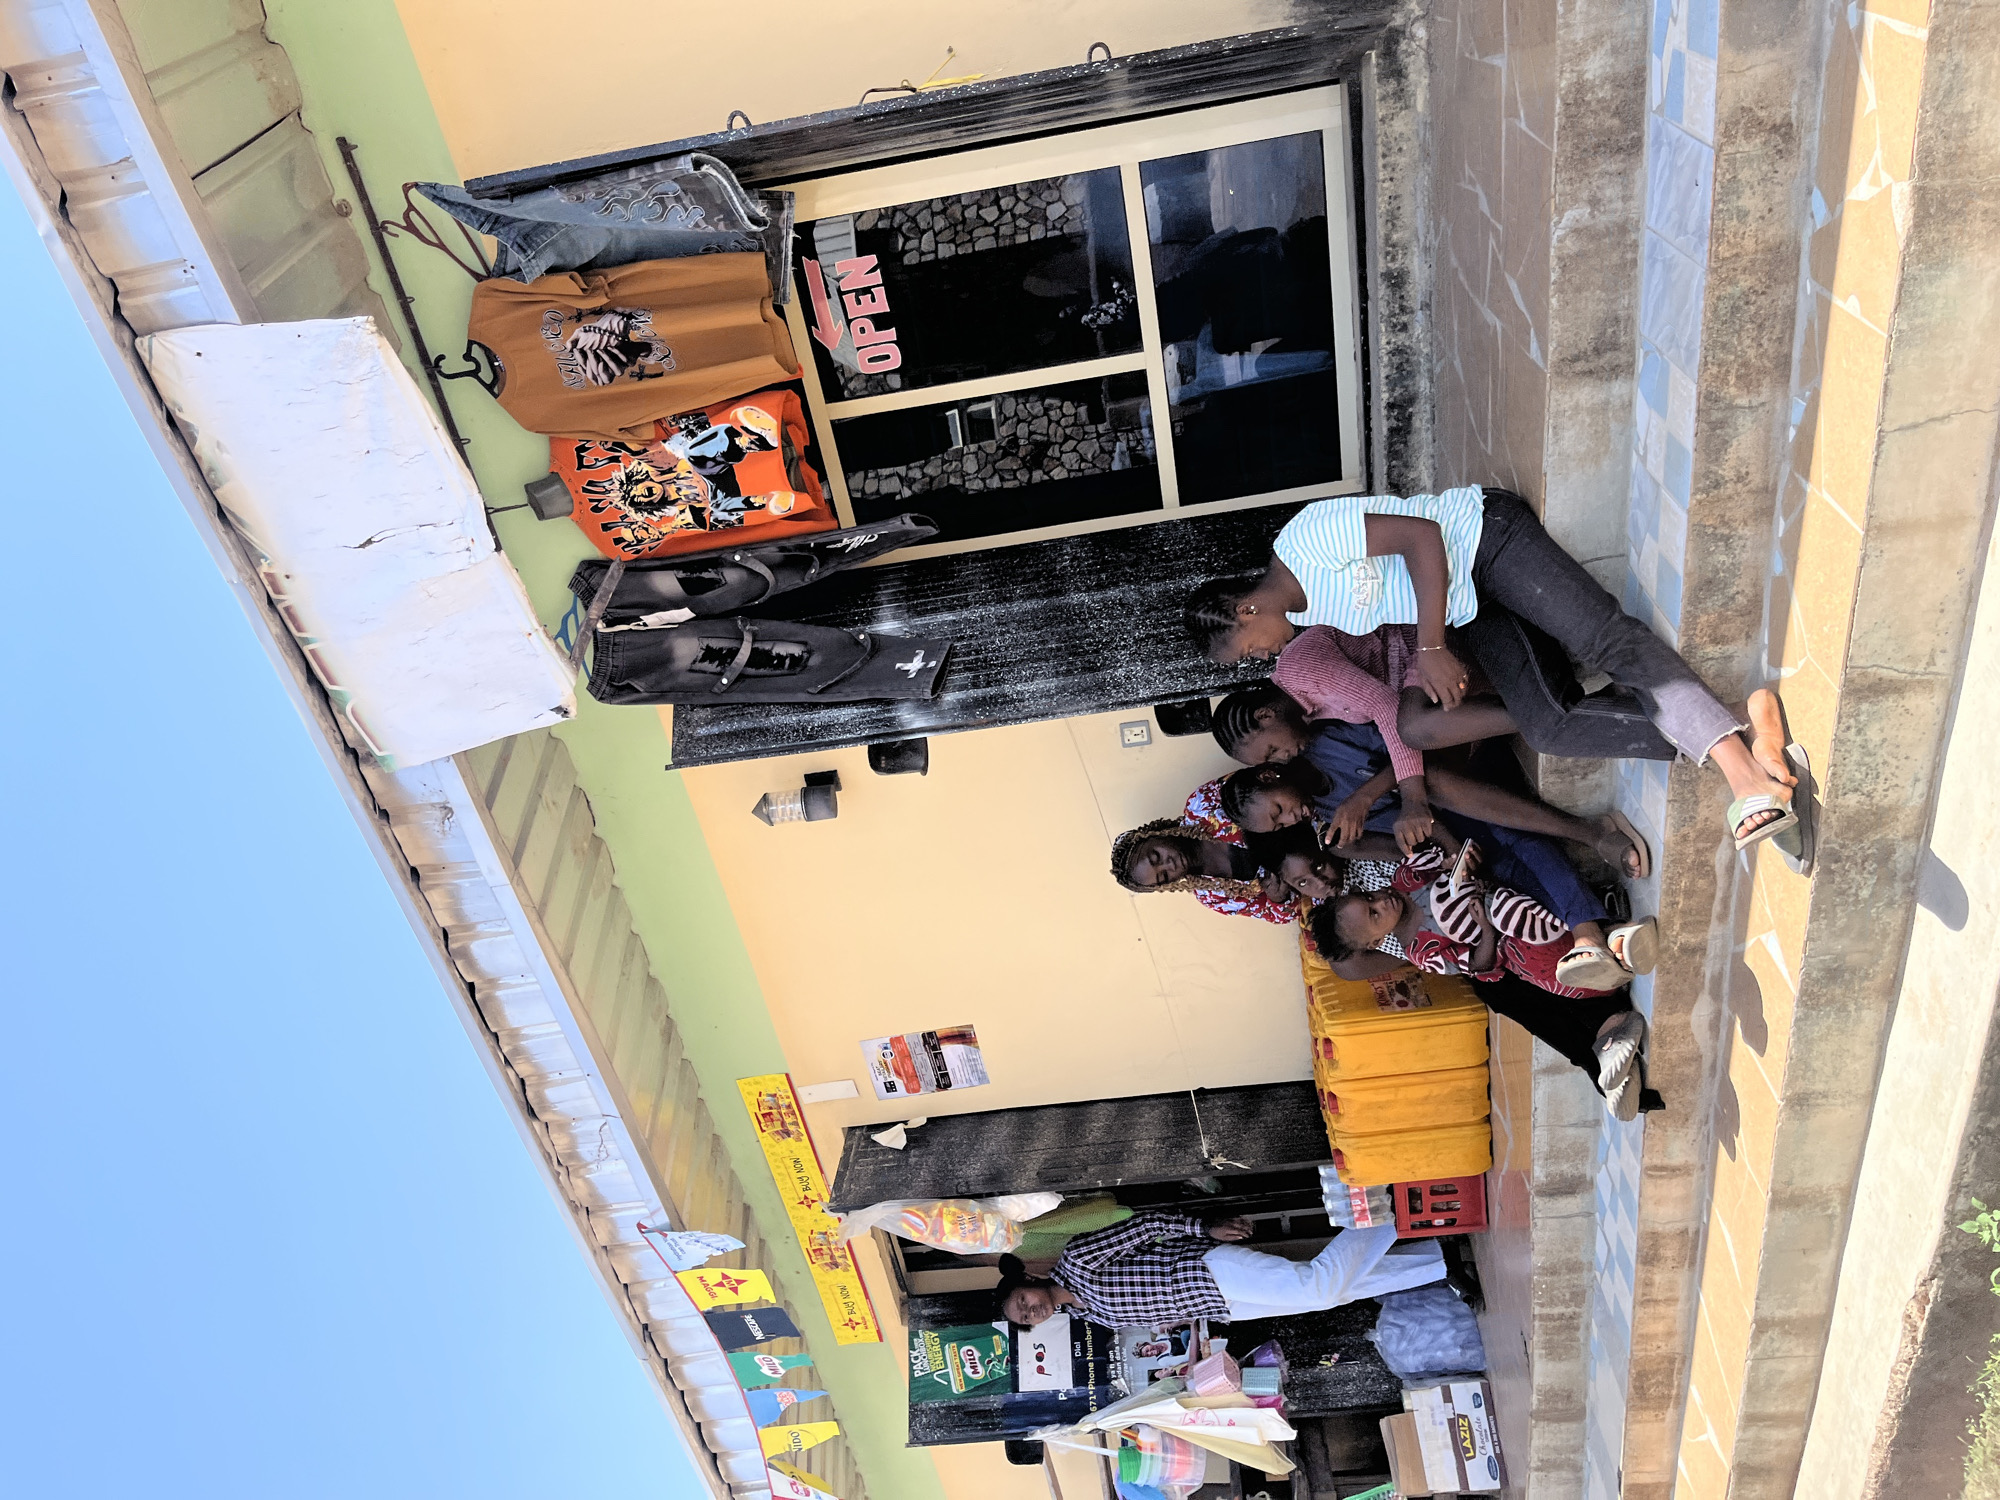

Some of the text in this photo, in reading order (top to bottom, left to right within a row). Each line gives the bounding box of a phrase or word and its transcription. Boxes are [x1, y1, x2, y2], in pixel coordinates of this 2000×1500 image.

[834, 254, 902, 374] OPEN
[790, 1157, 811, 1192] BUY NOW
[696, 1276, 718, 1298] MAGGI
[837, 1285, 856, 1315] BUY NOW
[762, 1356, 782, 1375] MILO
[910, 1348, 924, 1377] PACK
[918, 1338, 930, 1374] LUNCHBOX
[923, 1331, 936, 1372] NOURISHING
[930, 1332, 944, 1369] ENERGY
[966, 1349, 980, 1375] MILO
[1074, 1341, 1082, 1357] Dial
[1459, 1418, 1474, 1457] LAZIZ
[1475, 1416, 1488, 1456] Chocolate
